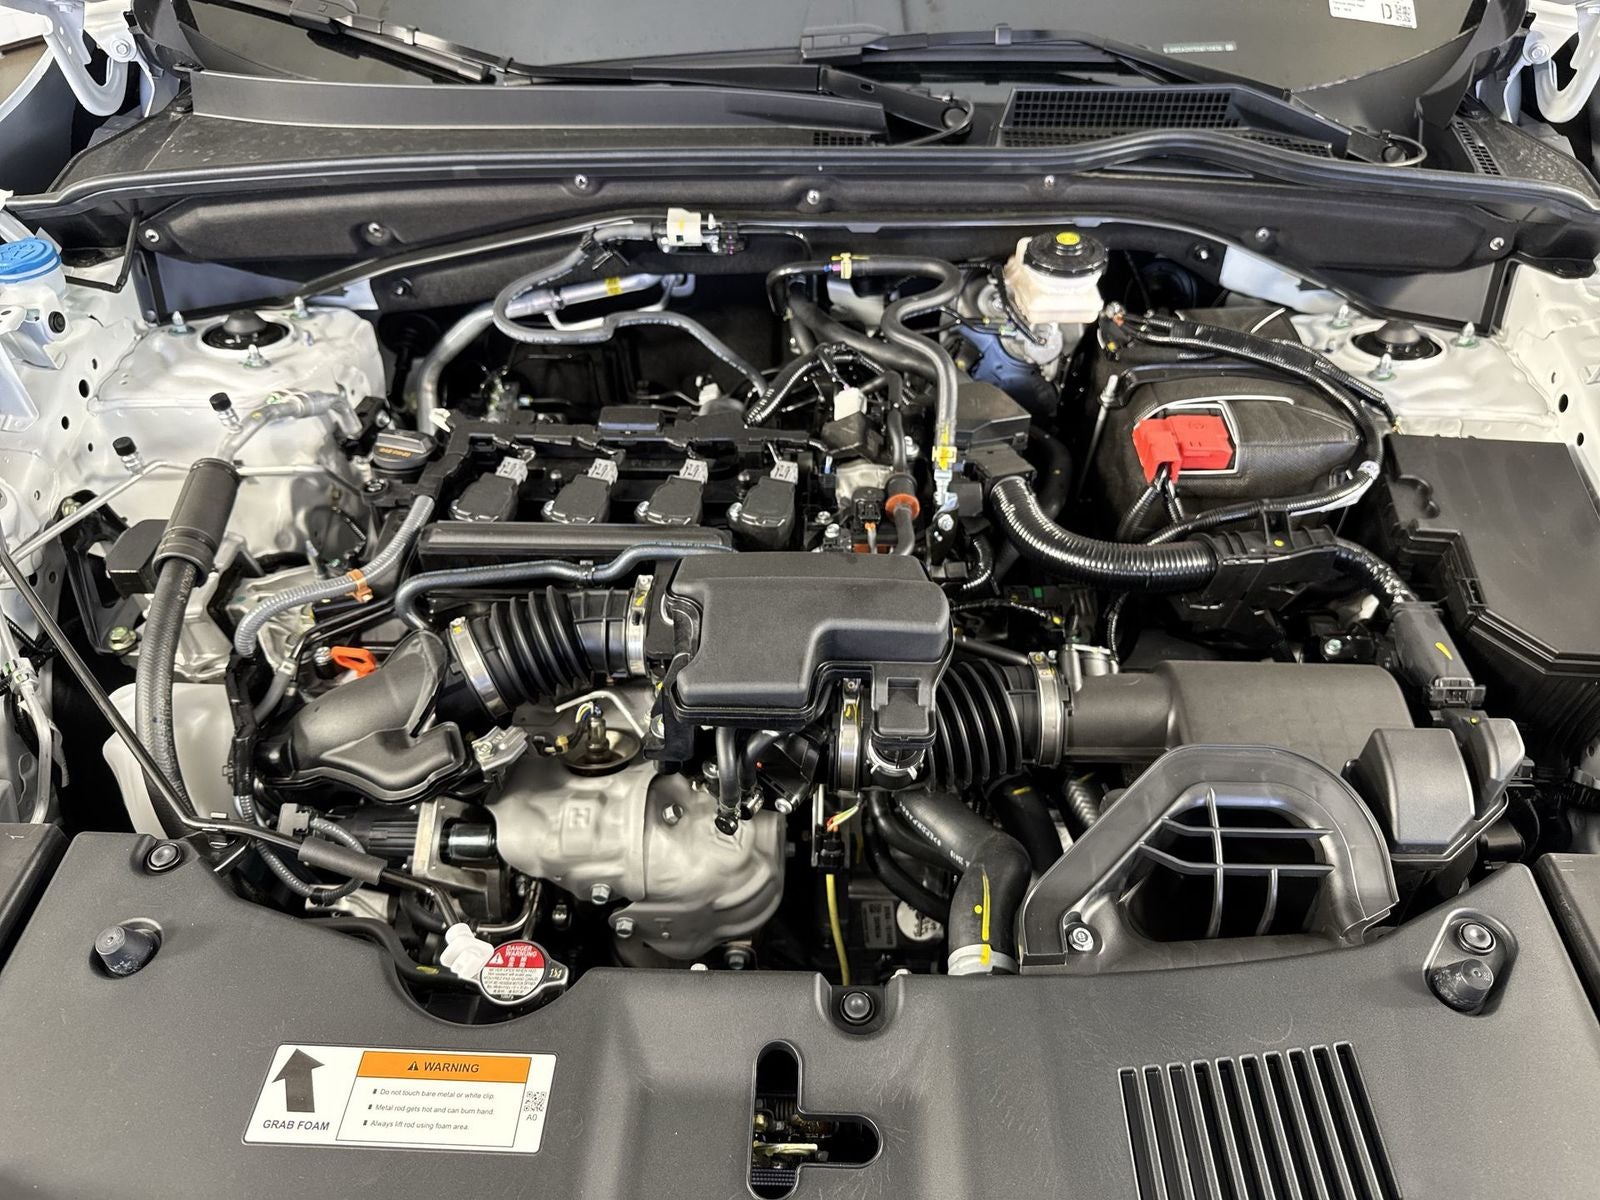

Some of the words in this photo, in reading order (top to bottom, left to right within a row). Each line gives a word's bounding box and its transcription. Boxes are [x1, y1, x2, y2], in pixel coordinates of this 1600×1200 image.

[424, 1062, 480, 1073] WARNING
[407, 1106, 421, 1114] gets
[263, 1119, 295, 1130] GRAB
[297, 1121, 330, 1131] FOAM
[370, 1120, 394, 1128] Always
[416, 1122, 434, 1130] using
